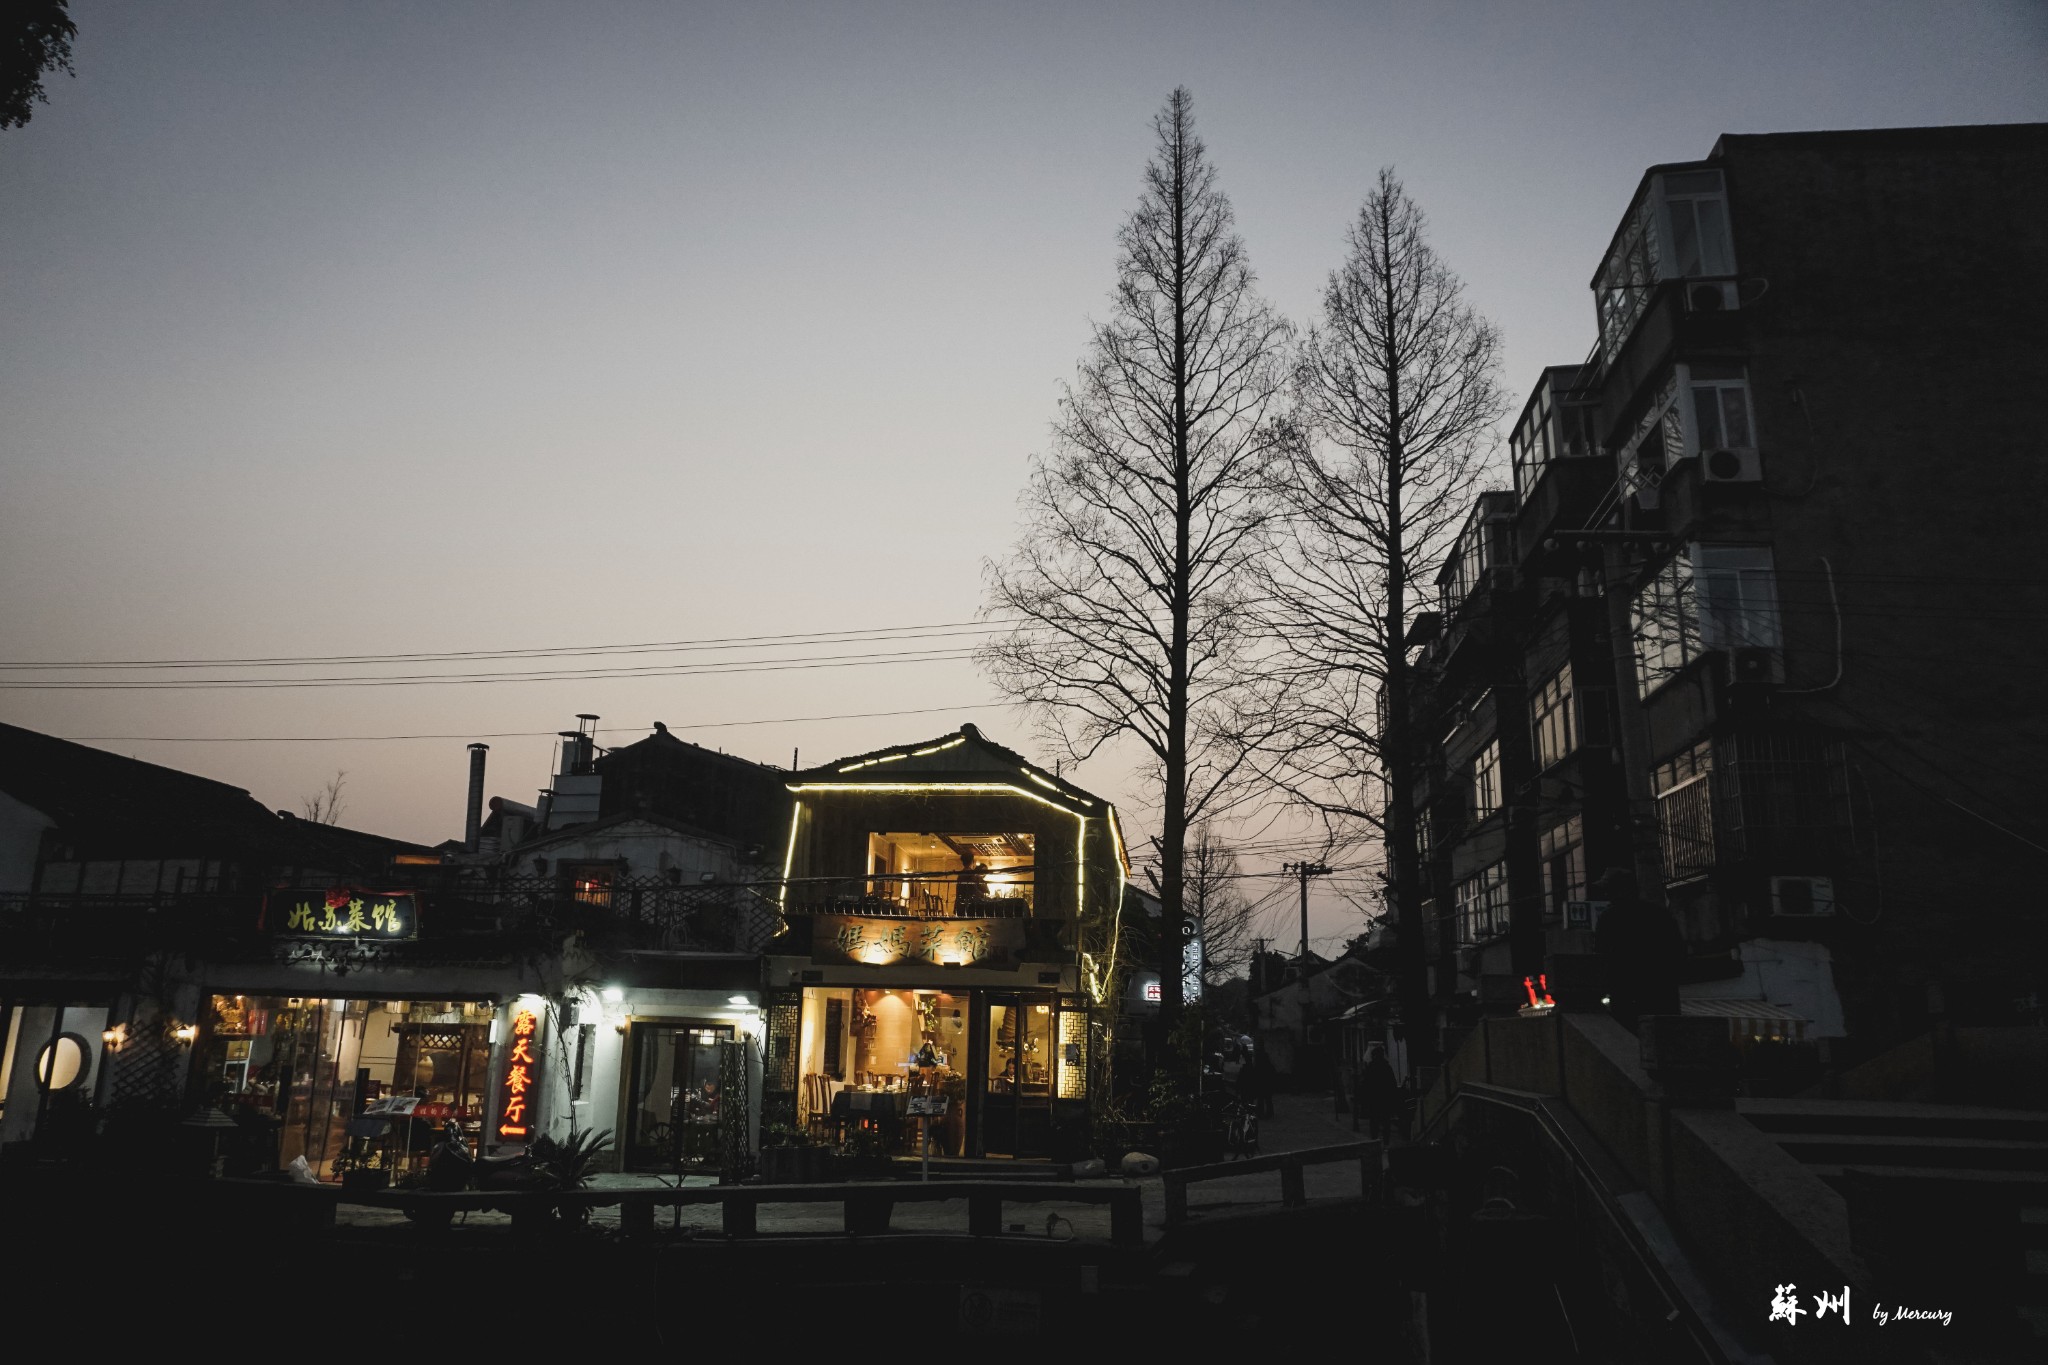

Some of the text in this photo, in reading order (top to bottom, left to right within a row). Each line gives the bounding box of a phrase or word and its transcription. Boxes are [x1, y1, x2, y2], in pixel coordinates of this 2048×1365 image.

[287, 898, 401, 932] 姑苏菜馆
[505, 1010, 536, 1124] 露天餐厅
